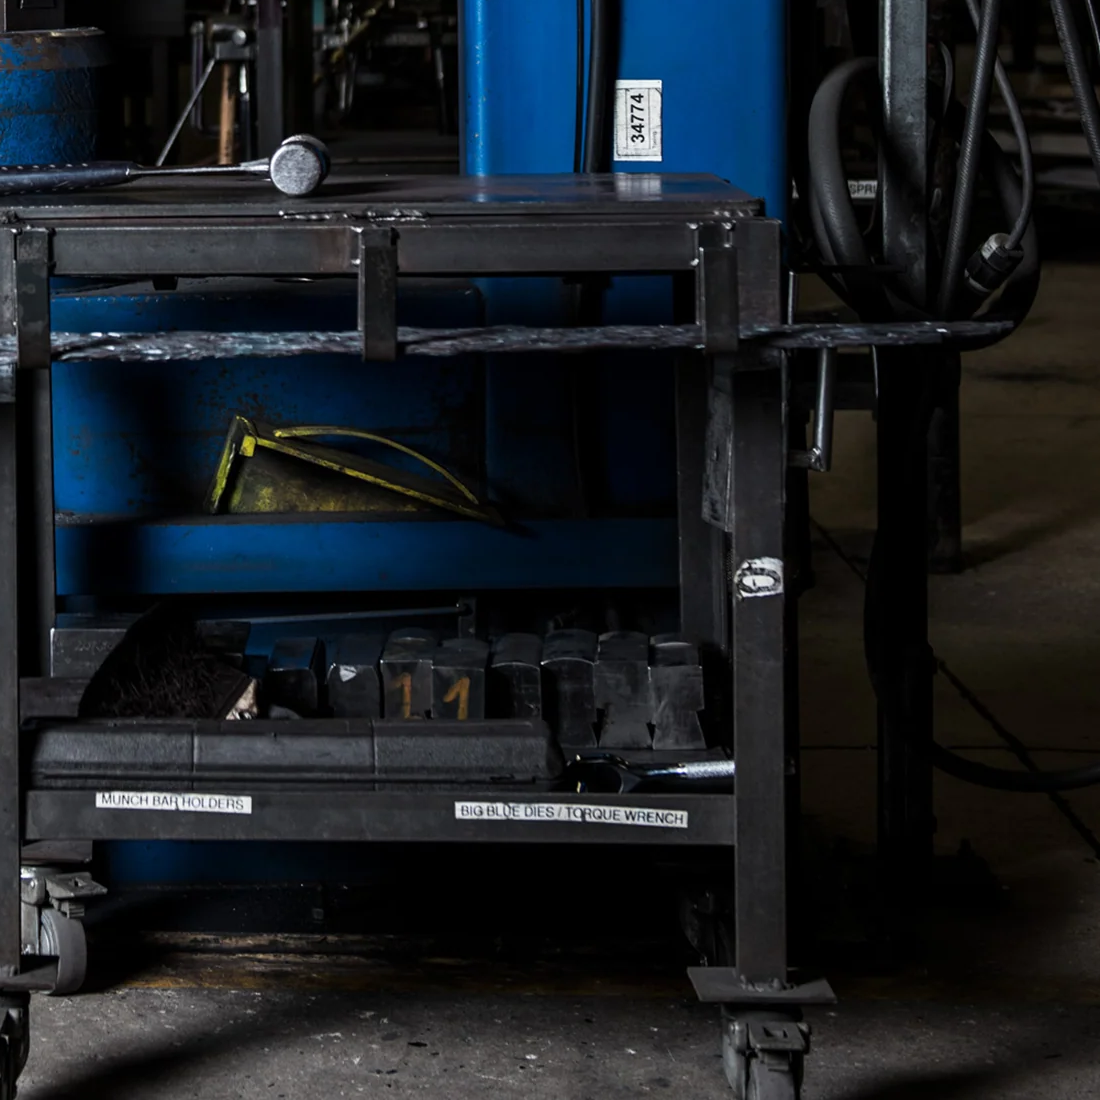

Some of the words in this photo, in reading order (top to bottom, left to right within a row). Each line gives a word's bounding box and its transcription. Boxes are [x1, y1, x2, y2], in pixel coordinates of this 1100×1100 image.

[630, 93, 645, 143] 34774
[101, 794, 148, 806] MUNCH
[152, 795, 180, 808] BAR
[182, 796, 245, 811] HOLDERS
[461, 804, 484, 817] BIG
[486, 805, 521, 818] BLUE
[524, 806, 555, 819] DIES
[565, 806, 621, 820] TORQUE
[625, 810, 685, 825] WRENCH
